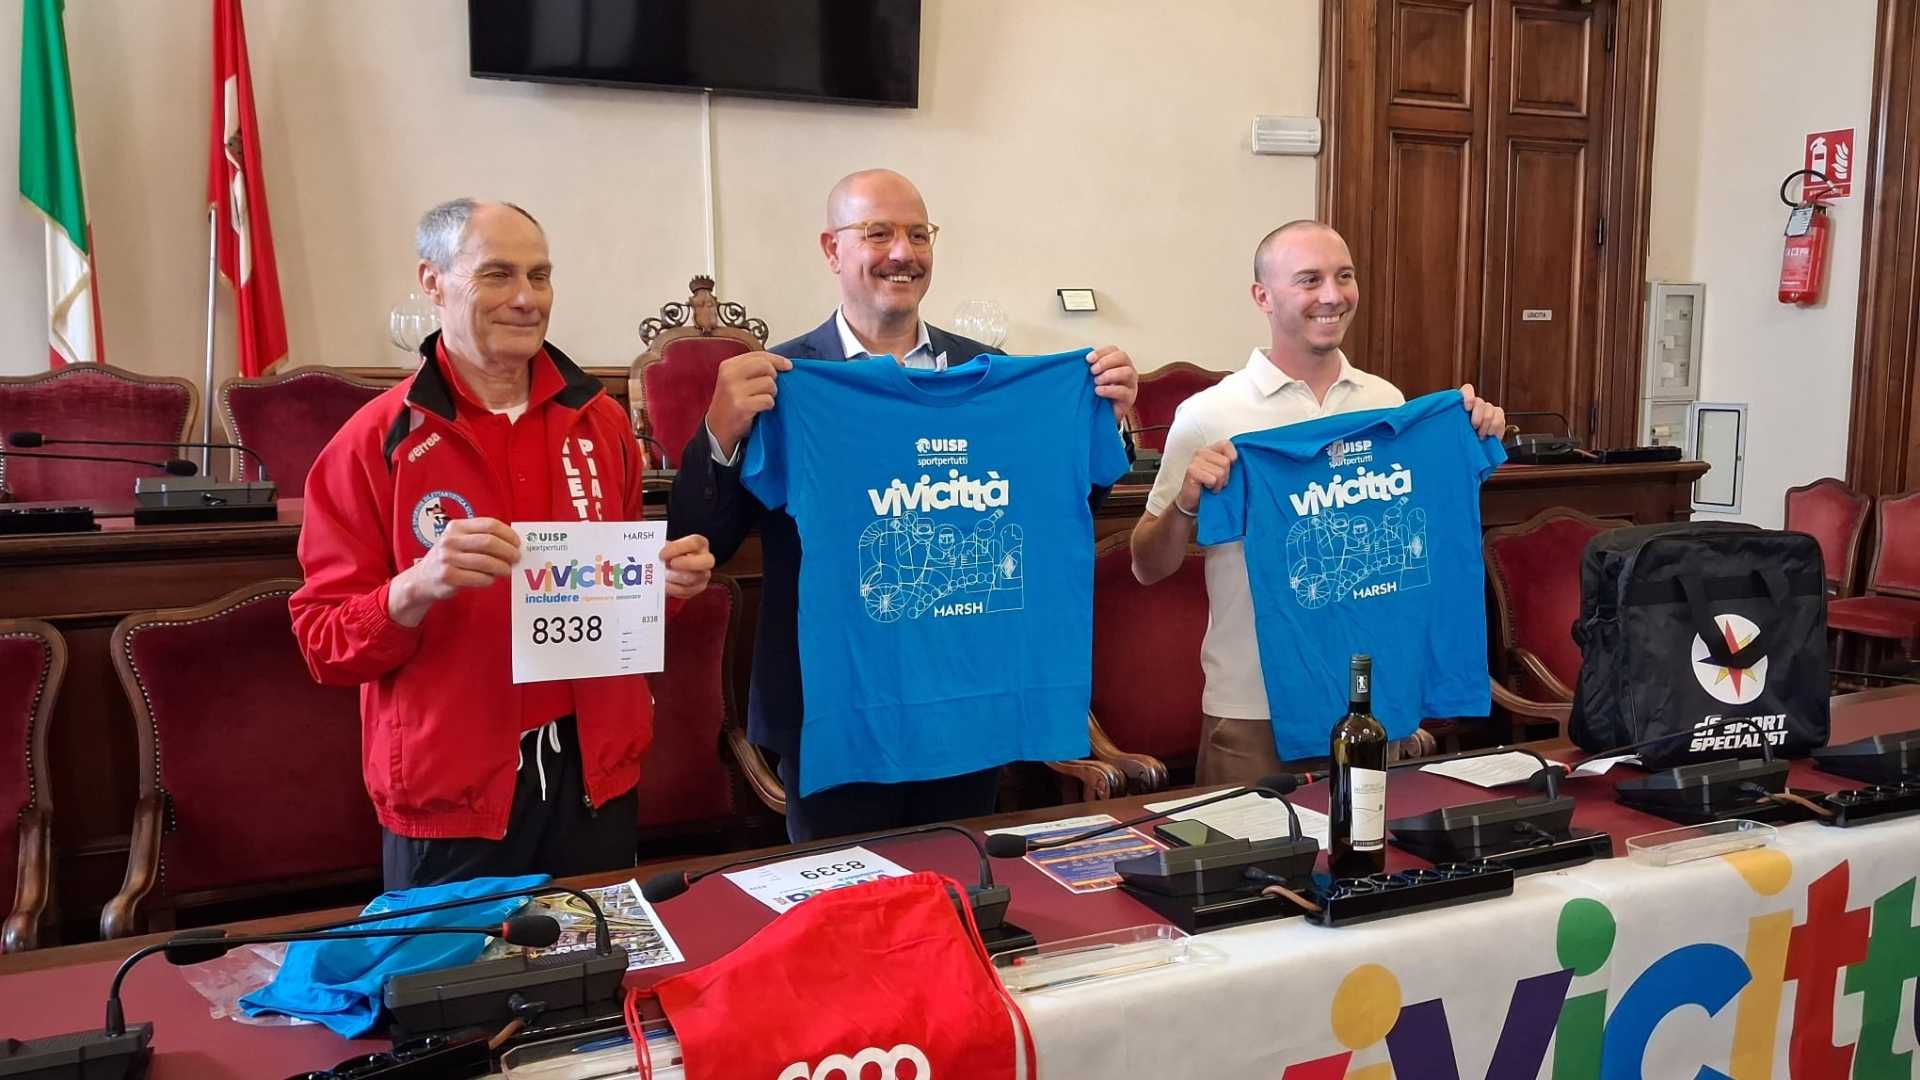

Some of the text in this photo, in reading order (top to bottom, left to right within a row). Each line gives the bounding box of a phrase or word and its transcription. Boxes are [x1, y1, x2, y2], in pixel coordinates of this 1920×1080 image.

[931, 439, 968, 452] UISP
[917, 456, 968, 467] sportpertutti
[868, 469, 1009, 517] vivicittà
[1289, 463, 1412, 516] vivicittà
[539, 533, 568, 541] UISP
[623, 532, 654, 540] MARSH
[524, 554, 642, 592] vivicittà
[525, 593, 579, 604] includere
[1353, 581, 1397, 600] MARSH
[934, 602, 983, 617] MARSH
[532, 615, 602, 645] 8338
[1688, 730, 1789, 752] SPECIALST
[800, 860, 866, 880] 8339
[1282, 846, 1920, 1080] vicitt
